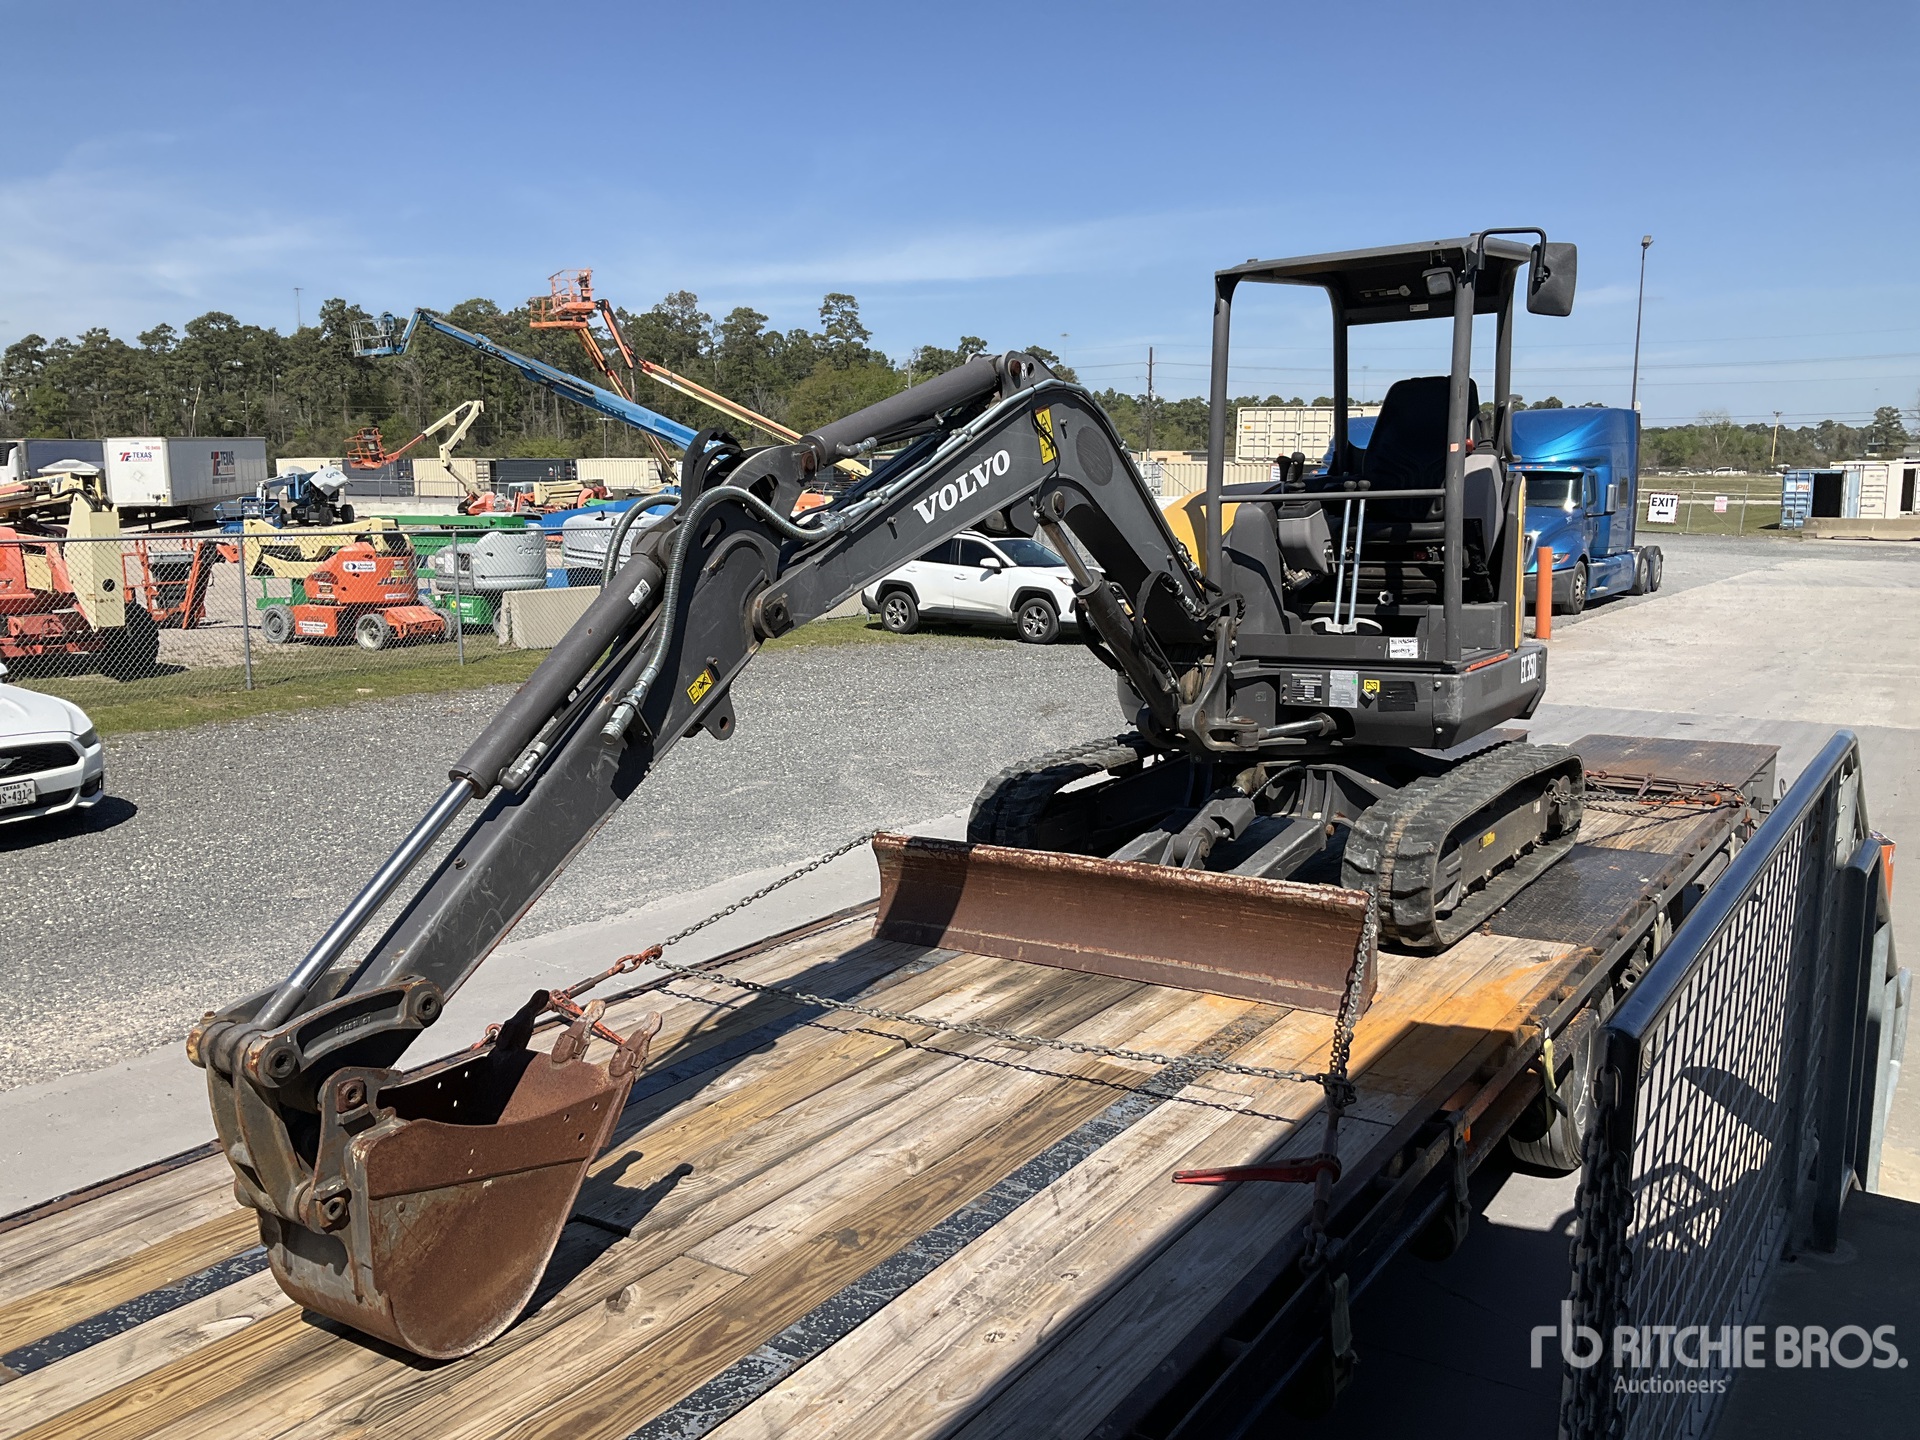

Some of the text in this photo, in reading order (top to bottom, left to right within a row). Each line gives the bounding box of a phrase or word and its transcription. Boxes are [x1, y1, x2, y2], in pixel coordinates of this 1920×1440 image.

[220, 451, 234, 465] TEXAS
[913, 450, 1010, 523] VOLVO
[1651, 497, 1676, 507] EXIT
